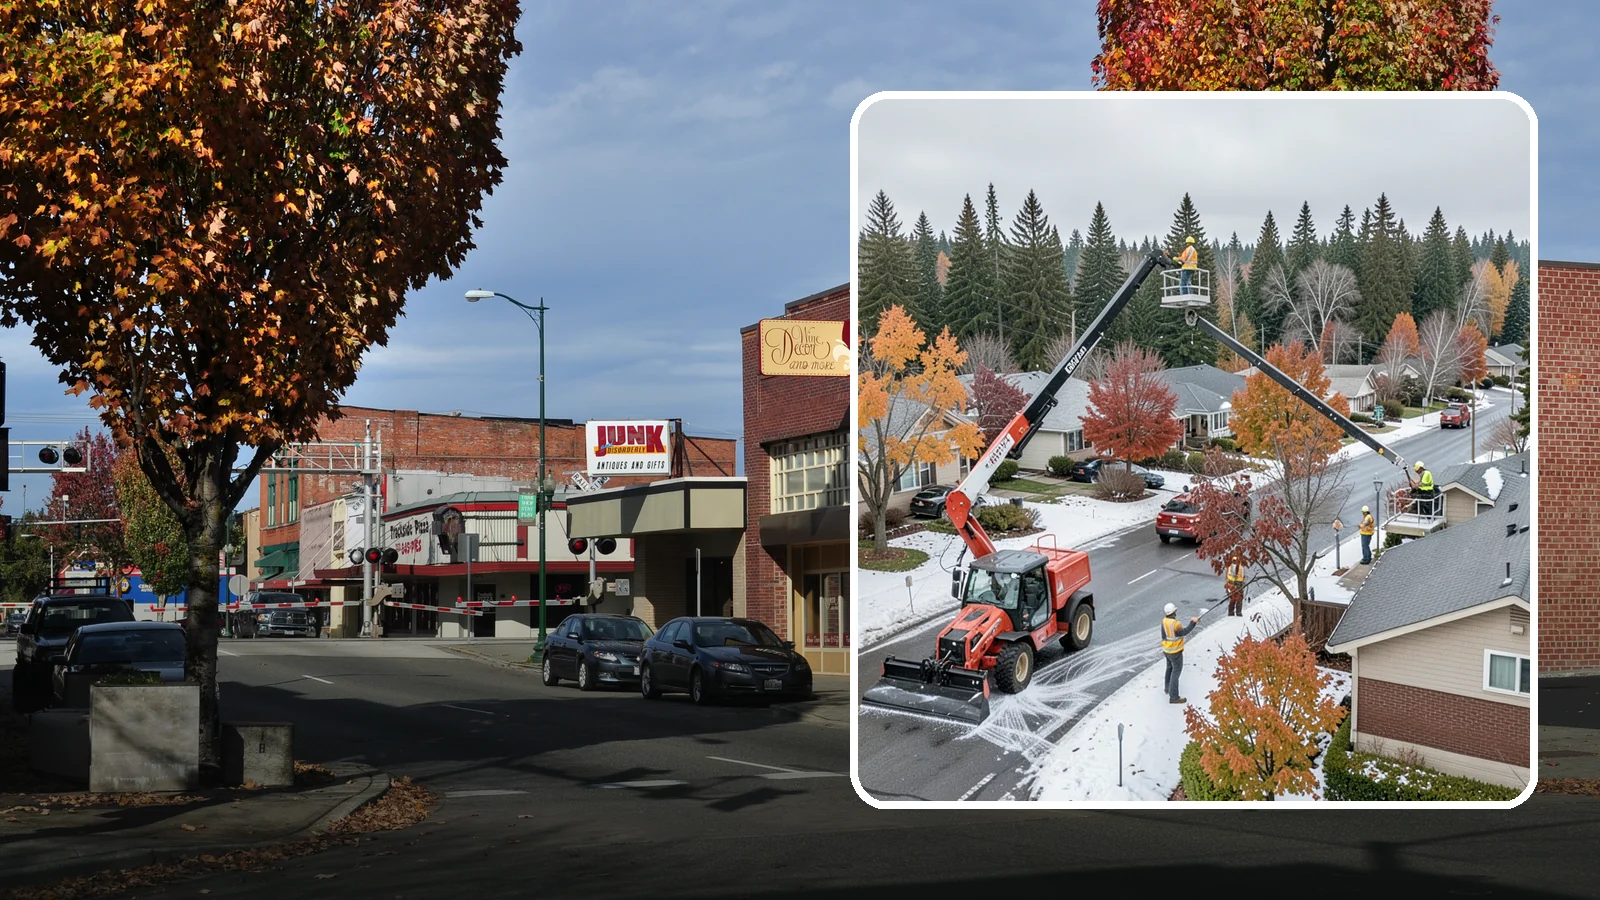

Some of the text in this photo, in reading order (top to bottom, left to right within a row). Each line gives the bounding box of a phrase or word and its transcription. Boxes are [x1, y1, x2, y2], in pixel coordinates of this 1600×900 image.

[595, 425, 665, 457] JUNK
[607, 446, 646, 454] DISORDERLY
[596, 460, 665, 470] ANTIQUES AND GIFTS
